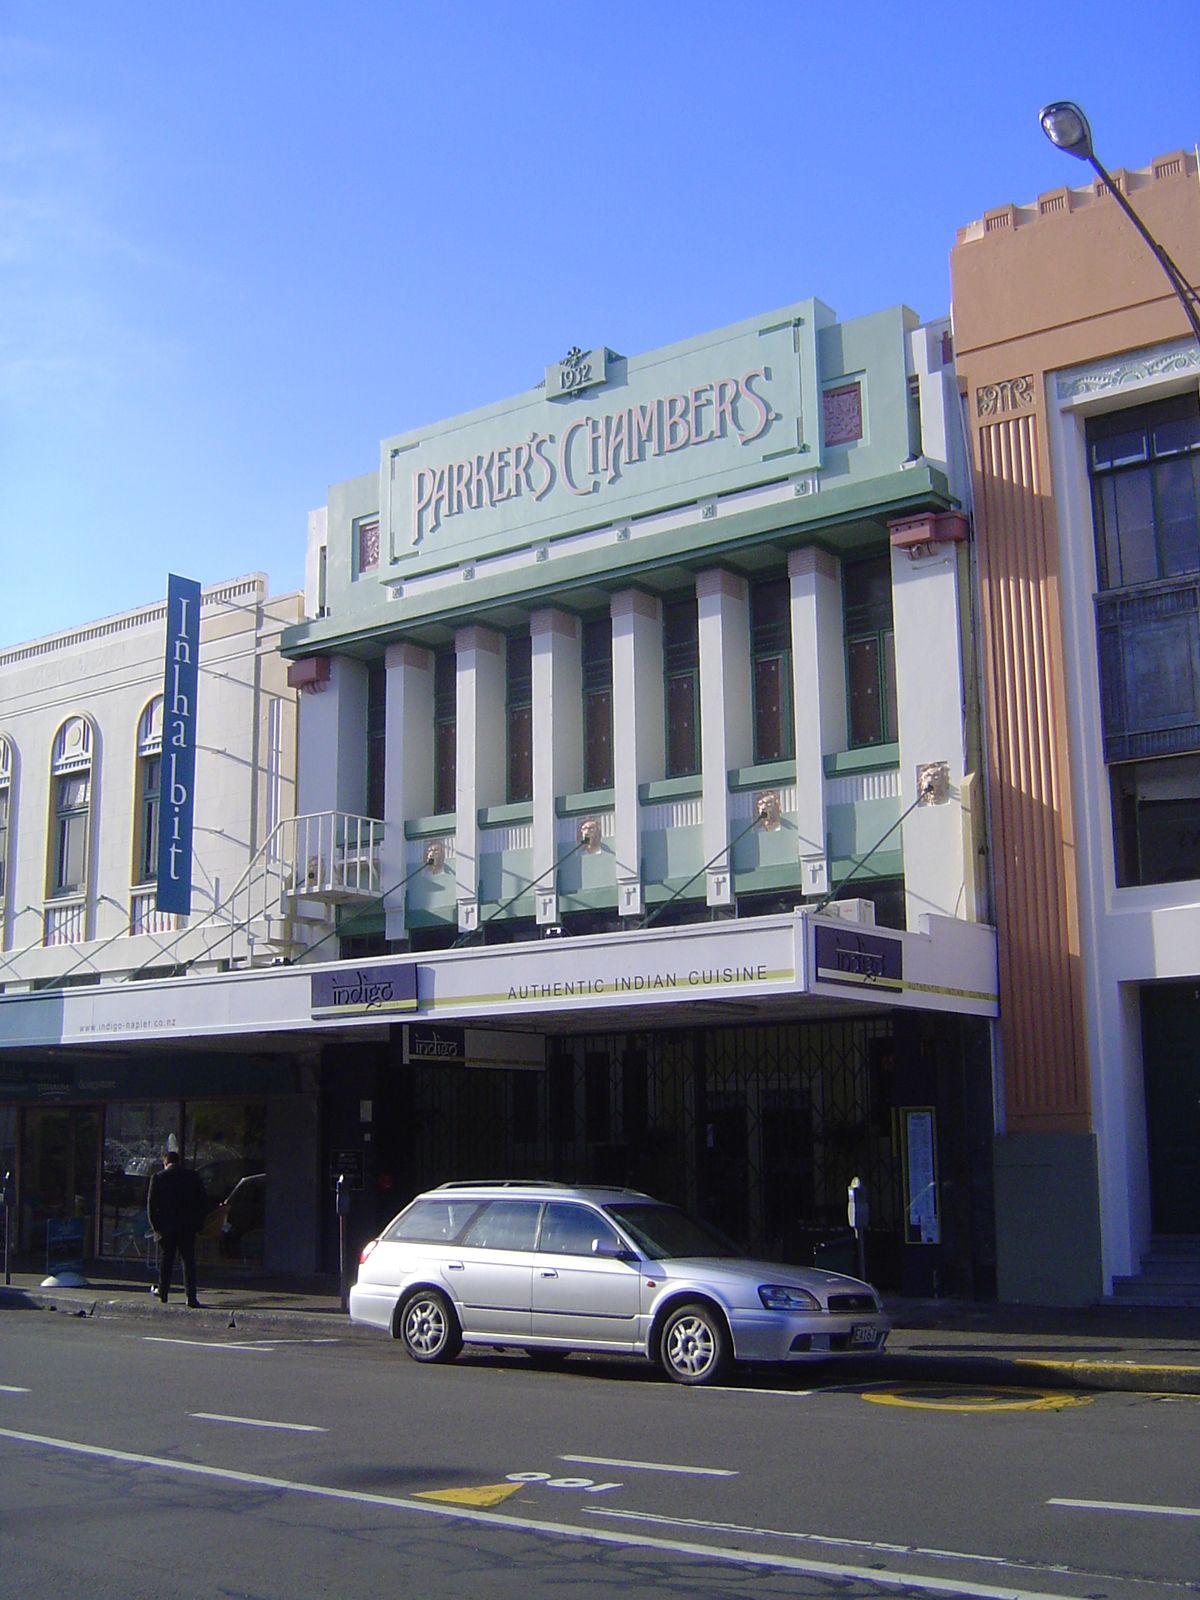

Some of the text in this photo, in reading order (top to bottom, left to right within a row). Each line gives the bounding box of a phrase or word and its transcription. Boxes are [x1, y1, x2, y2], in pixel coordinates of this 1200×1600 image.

[560, 363, 593, 390] 1932
[412, 432, 555, 546] PARKER'S
[169, 597, 191, 881] Inhabit
[332, 970, 395, 1012] indigo
[507, 964, 768, 1000] AUTHENTIC INDIAN CUISINE
[79, 1018, 177, 1034] www.indigo-napier.co.nz
[414, 1031, 458, 1056] indigo
